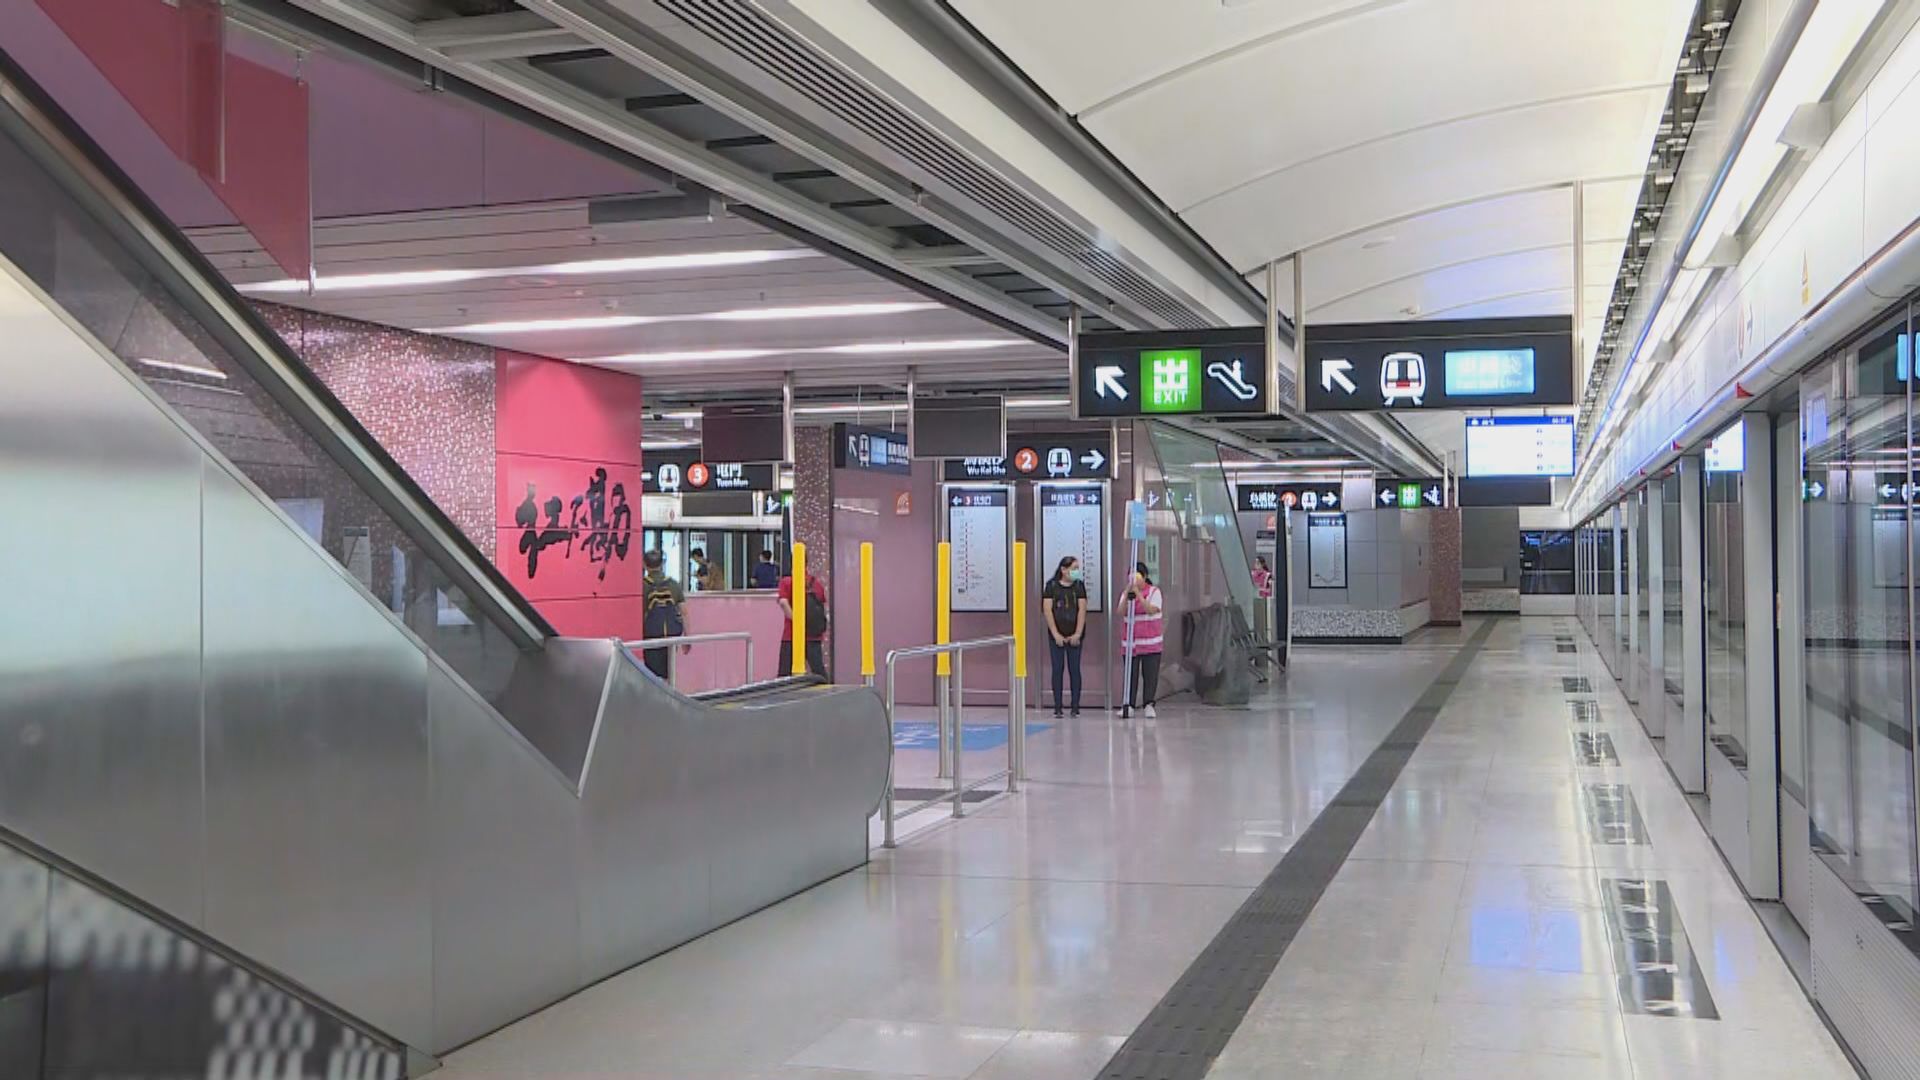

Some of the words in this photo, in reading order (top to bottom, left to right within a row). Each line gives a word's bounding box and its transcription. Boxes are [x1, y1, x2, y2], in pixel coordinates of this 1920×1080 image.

[1153, 357, 1188, 389] 出
[1153, 389, 1188, 405] EXIT
[1021, 451, 1032, 470] 2
[692, 466, 703, 484] 3
[966, 465, 980, 476] Wu
[716, 477, 733, 488] Tuen
[733, 477, 749, 487] Mun
